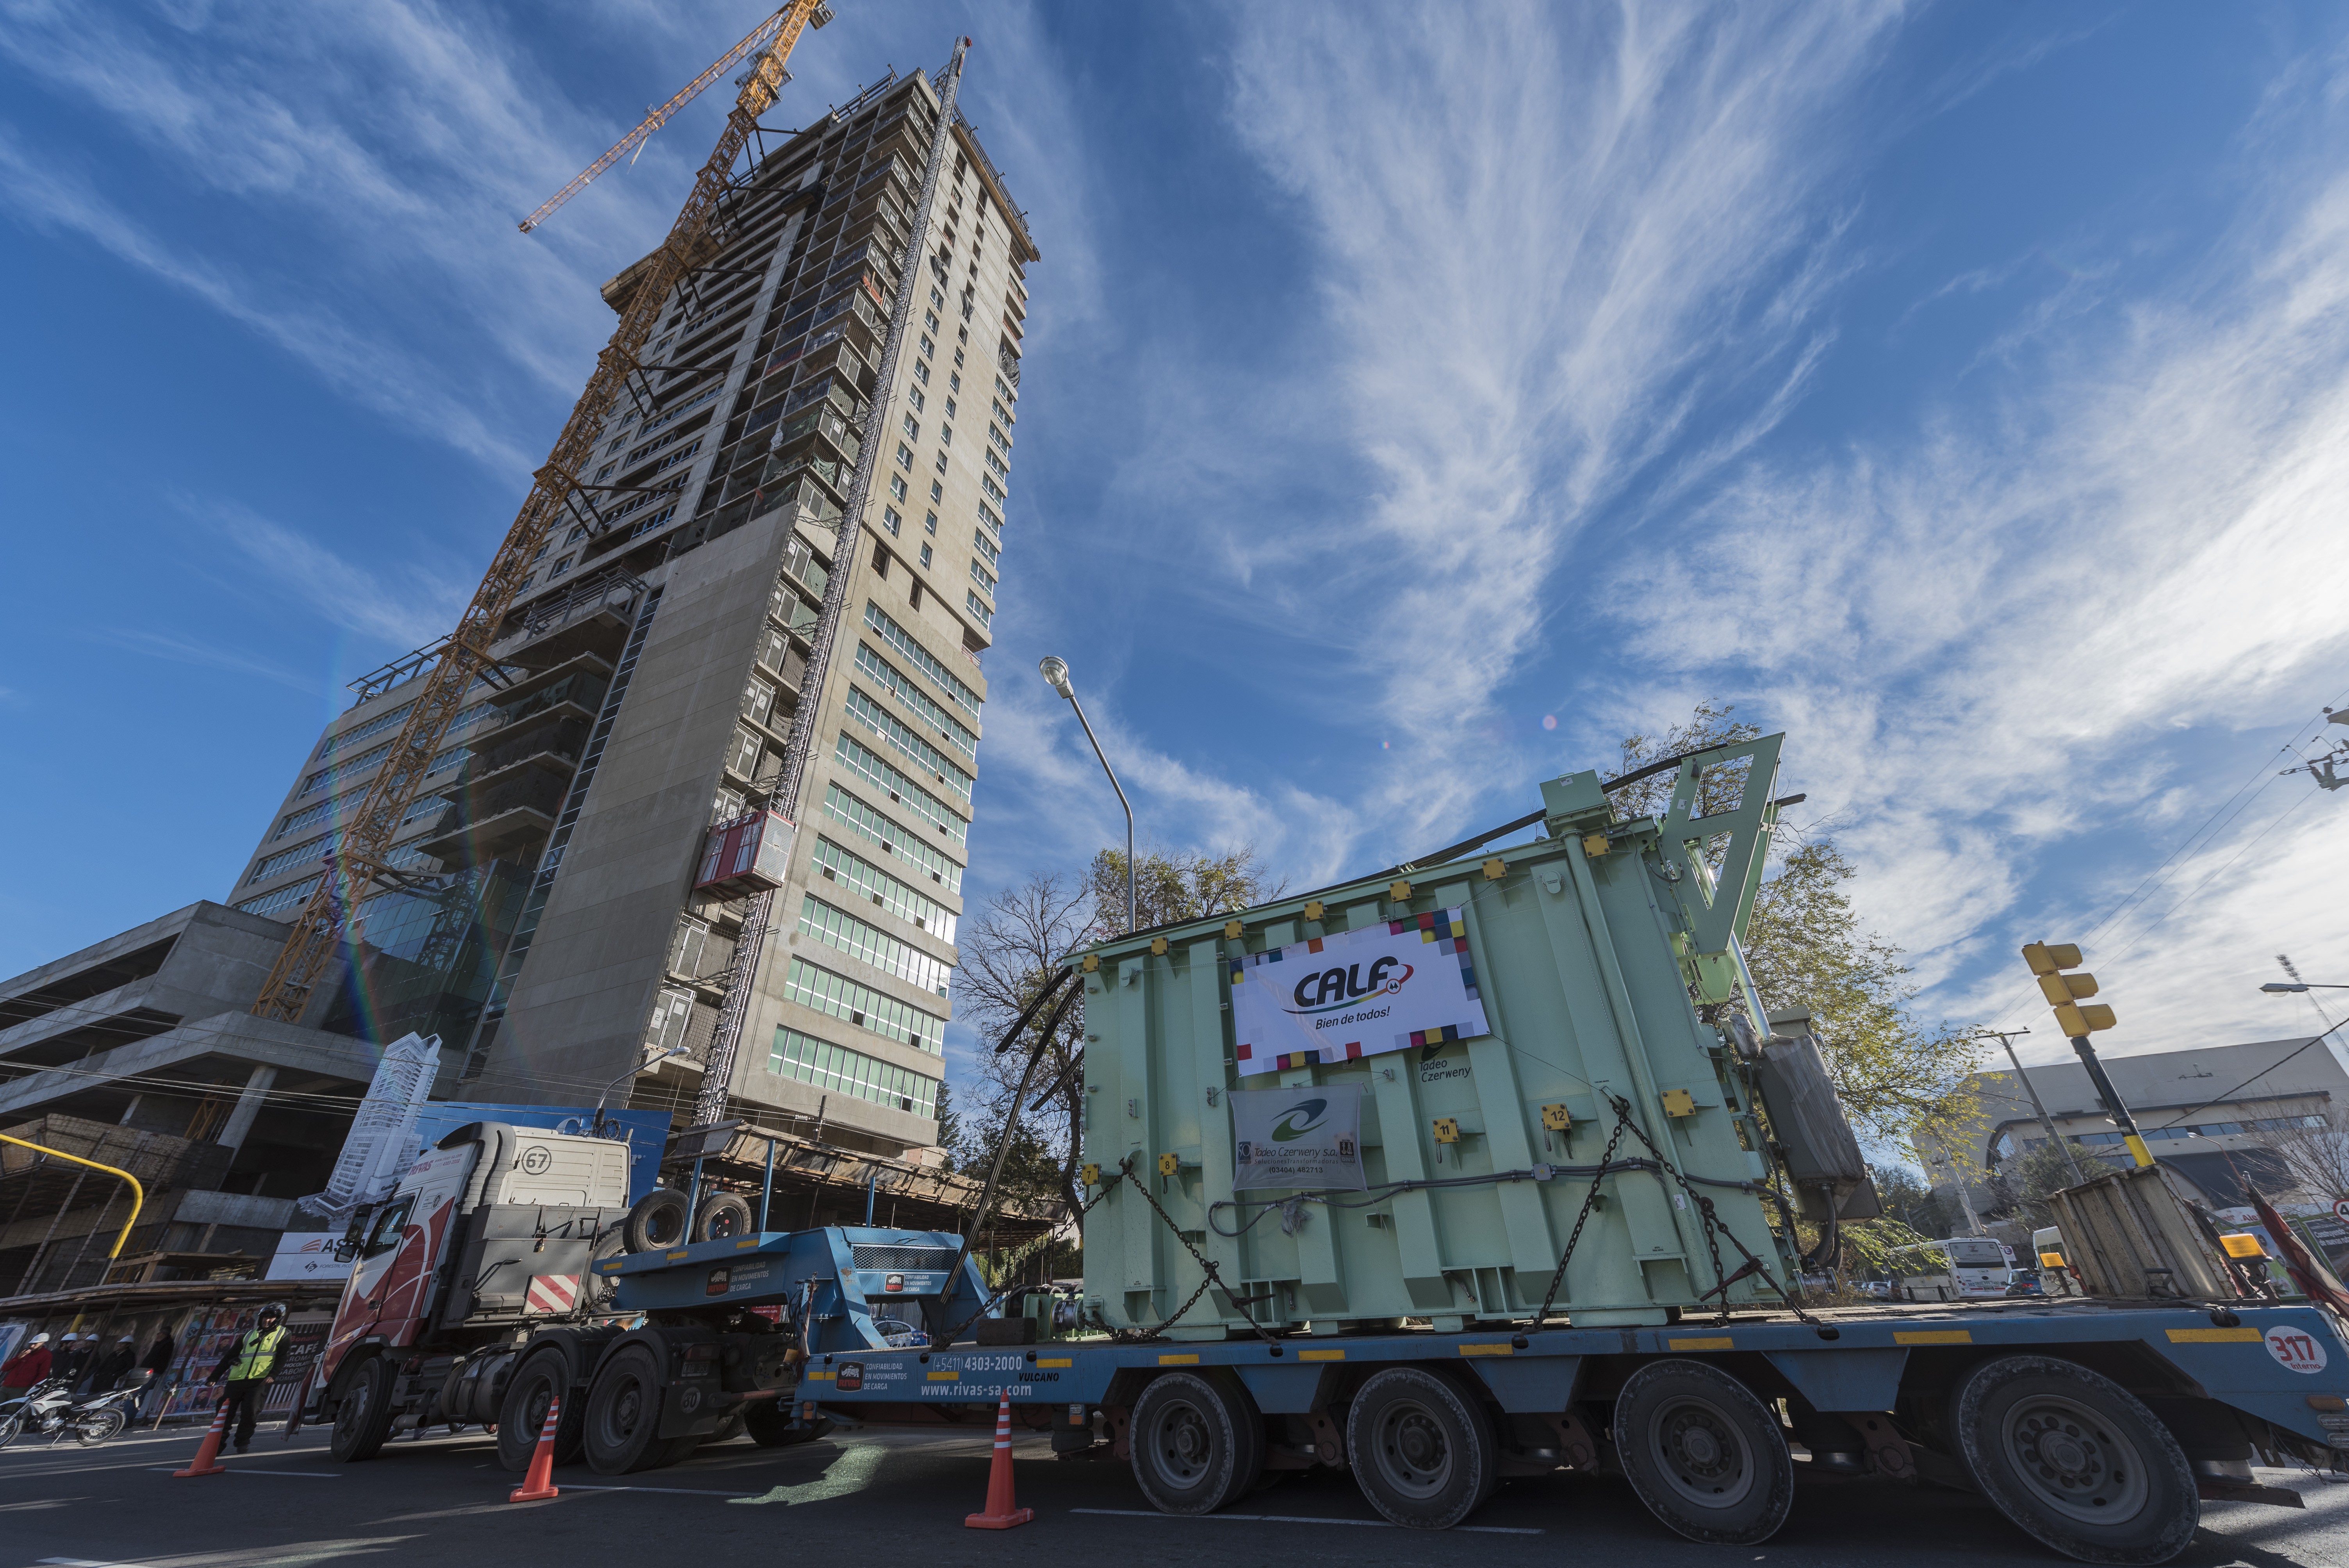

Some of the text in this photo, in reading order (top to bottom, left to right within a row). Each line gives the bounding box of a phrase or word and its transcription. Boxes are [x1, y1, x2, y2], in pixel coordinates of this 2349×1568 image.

[1294, 956, 1399, 1007] CALF
[1315, 1005, 1390, 1030] Bien de todos!
[1419, 1059, 1447, 1072] Tadeo
[1421, 1067, 1471, 1083] Czerweny
[1551, 1110, 1566, 1122] 12
[1439, 1124, 1450, 1135] 11
[1254, 1147, 1338, 1159] Tadeo Czerweny s.a.
[526, 1153, 548, 1169] 67
[1165, 1161, 1170, 1170] 8
[408, 1159, 434, 1176] RIVAS
[1087, 1171, 1091, 1180] 7
[733, 1261, 766, 1273] CONFIABILIDAD
[738, 1270, 769, 1281] MOVIMIENTOS
[707, 1283, 727, 1293] RIVAS
[736, 1283, 751, 1292] CARGA
[2269, 1335, 2315, 1361] 317
[933, 1356, 1022, 1372] (+5411) 4303-2000
[278, 1367, 307, 1375] ABORE
[1018, 1372, 1059, 1383] VULCANO
